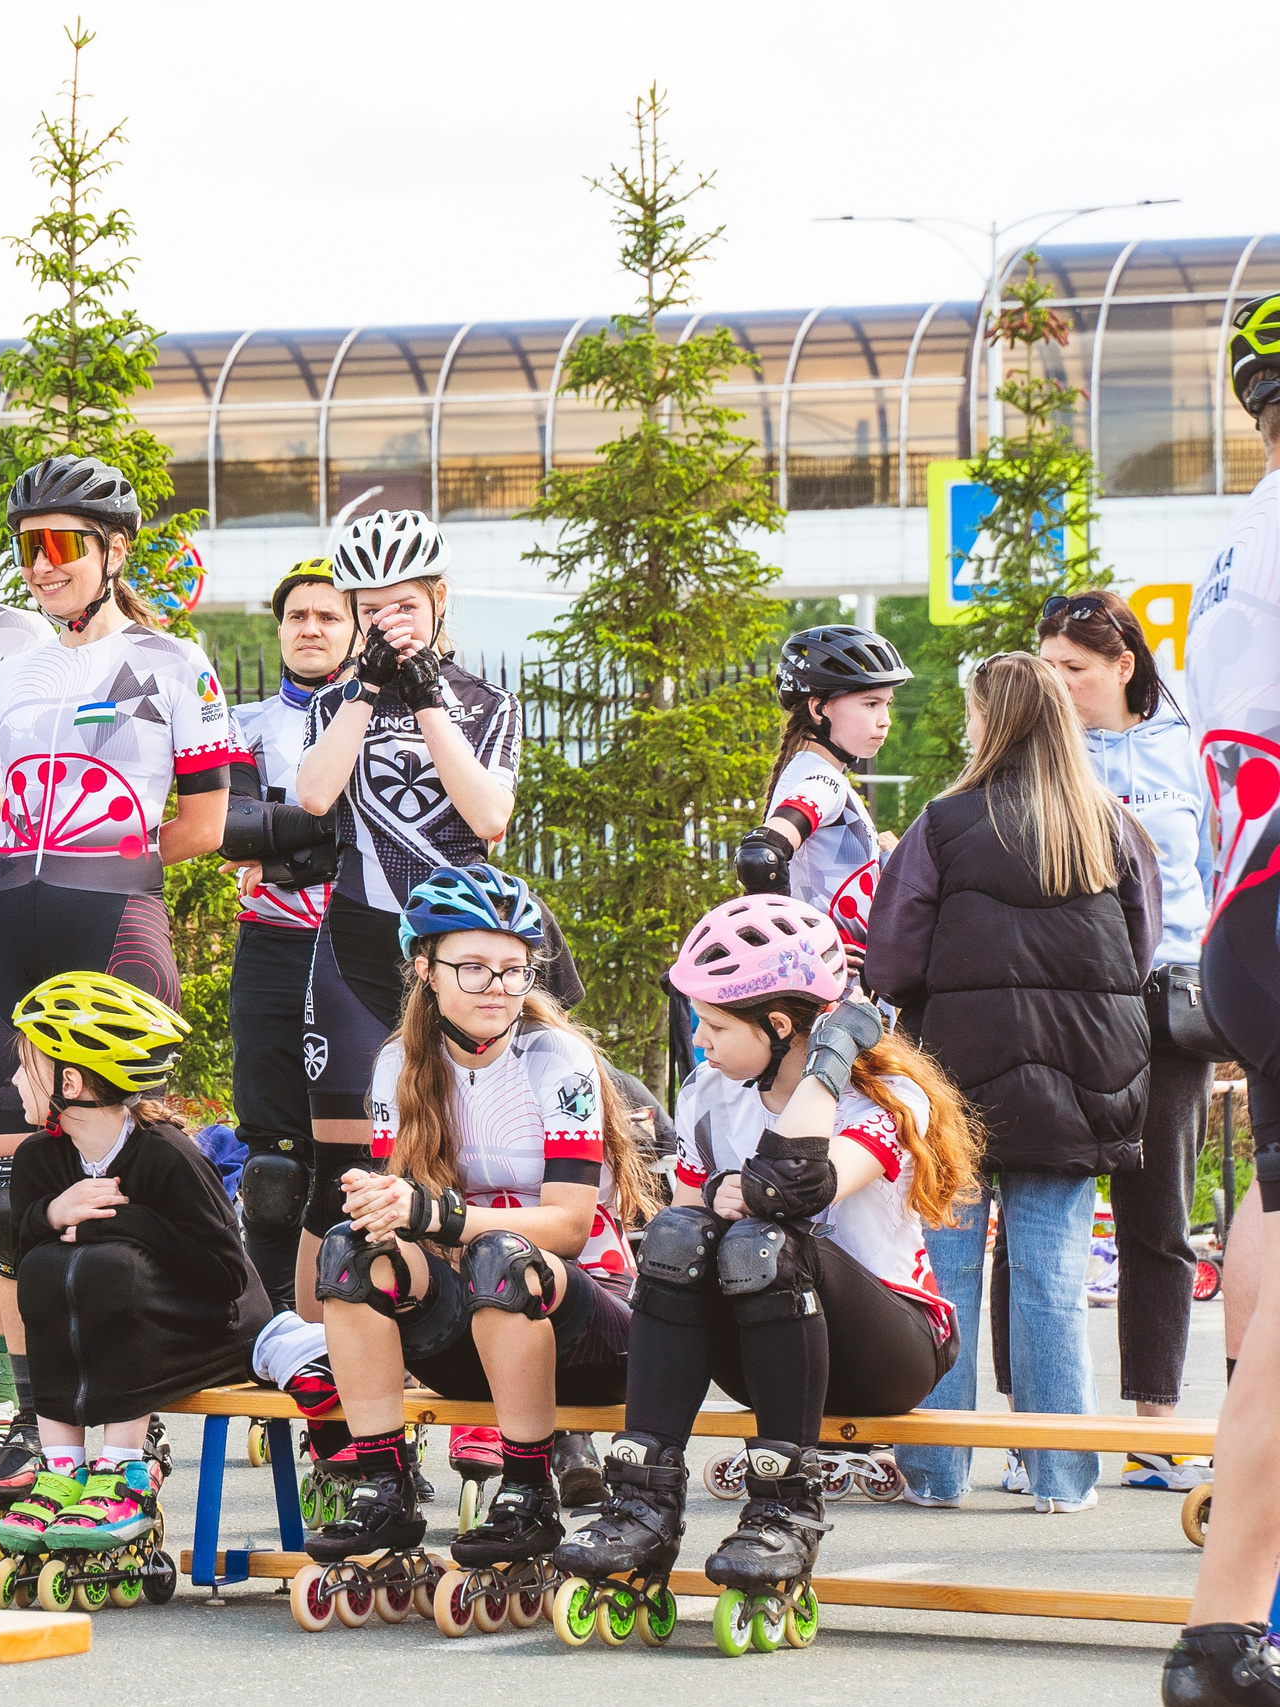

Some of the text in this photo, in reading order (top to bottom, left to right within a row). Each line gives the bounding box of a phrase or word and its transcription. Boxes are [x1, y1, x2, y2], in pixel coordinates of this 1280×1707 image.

[364, 704, 484, 731] YING GLE
[1135, 791, 1187, 804] HILFIG
